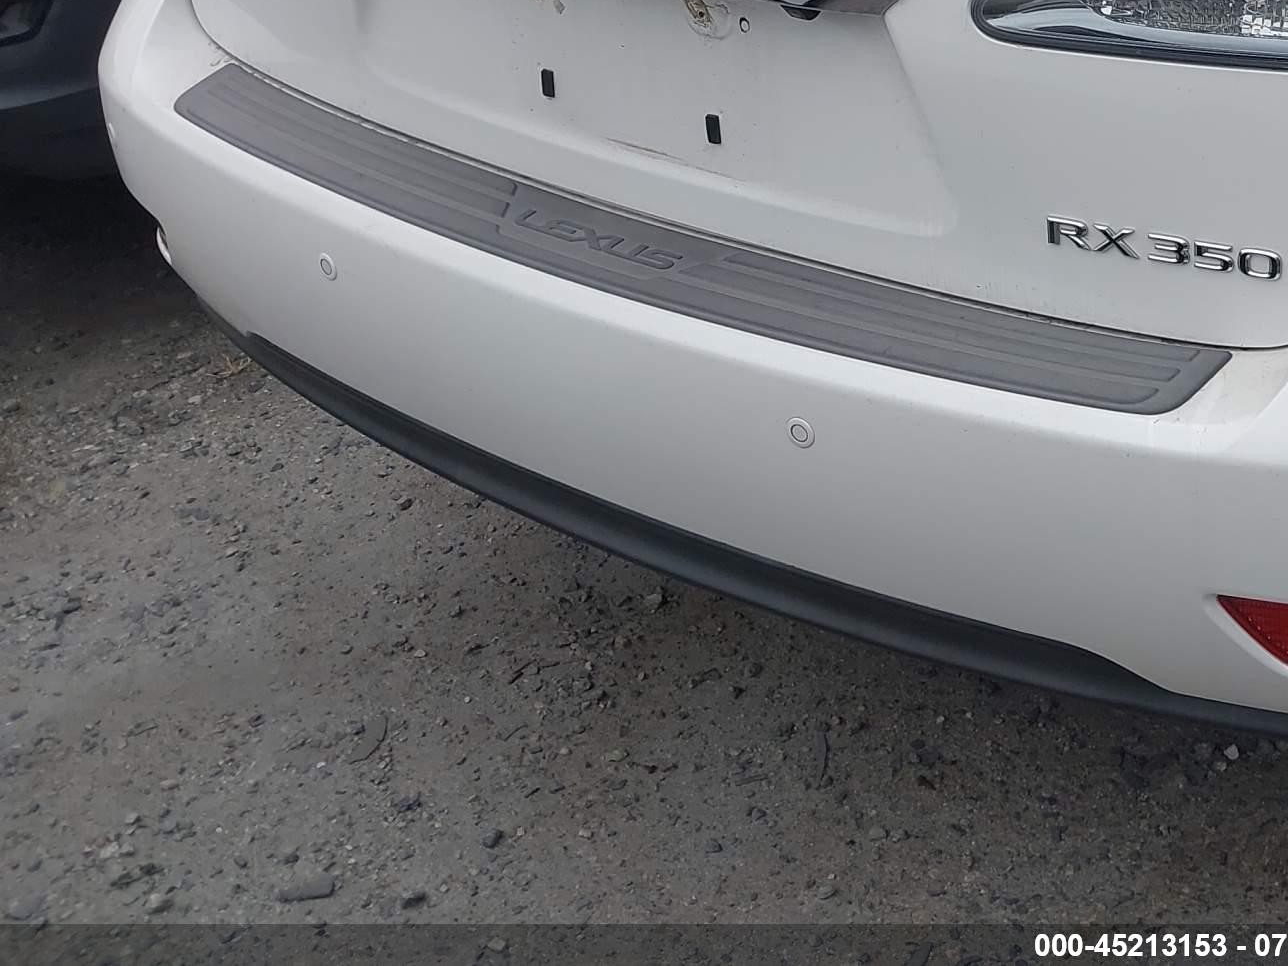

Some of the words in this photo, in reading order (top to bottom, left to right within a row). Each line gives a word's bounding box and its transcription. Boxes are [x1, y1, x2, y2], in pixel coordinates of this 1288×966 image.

[514, 208, 684, 271] LEXUS
[1046, 214, 1139, 260] RX
[1147, 232, 1283, 281] 350
